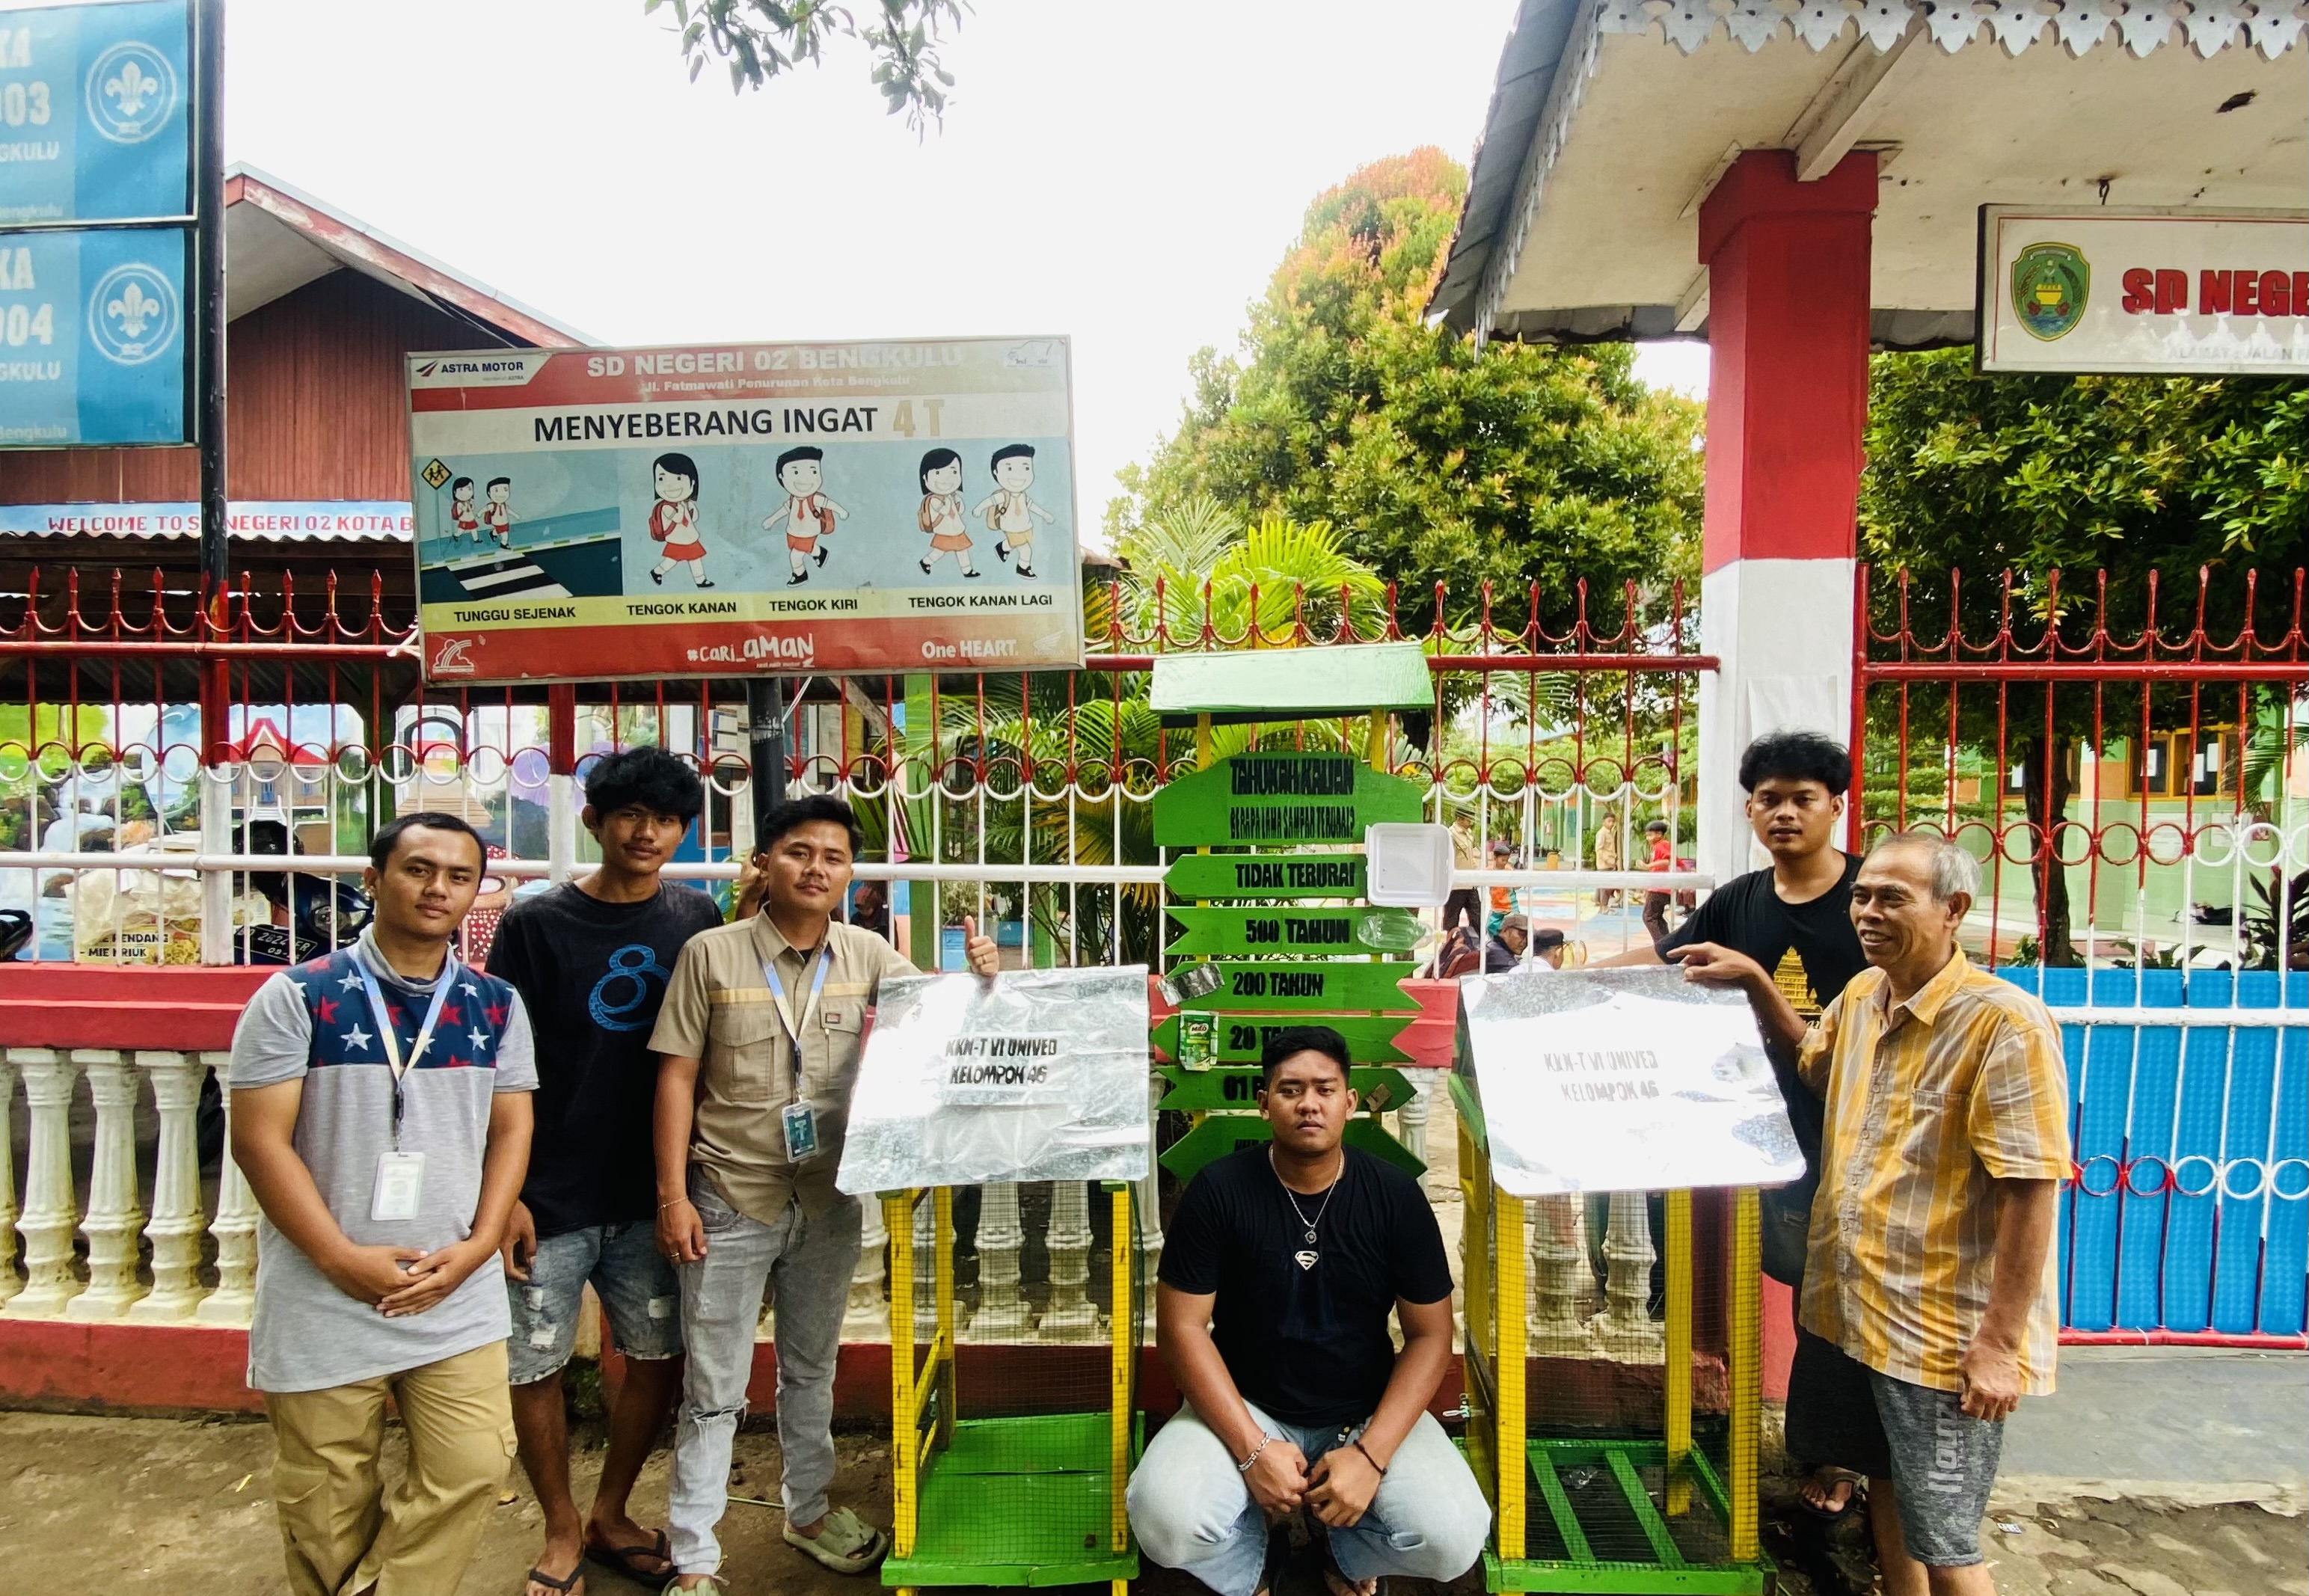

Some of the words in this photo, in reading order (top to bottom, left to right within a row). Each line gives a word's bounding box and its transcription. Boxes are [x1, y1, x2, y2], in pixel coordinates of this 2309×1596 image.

[0, 81, 51, 126] 03
[2121, 268, 2188, 316] SD
[0, 302, 54, 347] 04
[441, 363, 479, 374] ASTRA
[482, 361, 524, 372] MOTOR
[586, 356, 625, 378] SD
[635, 352, 744, 375] NEGERI
[753, 350, 789, 372] 02
[798, 346, 963, 370] BENGKULU
[664, 380, 734, 392] Fatmawati
[738, 378, 809, 389] Penurunan
[812, 376, 844, 387] Kota
[848, 375, 910, 388] Bengkulu
[534, 408, 773, 443] MENYEBERANG
[783, 407, 879, 434] INGAT
[48, 515, 148, 532] WELCOME
[156, 515, 183, 530] TO
[187, 516, 200, 530] S
[304, 515, 332, 531] 02
[337, 515, 394, 531] KOTA
[627, 603, 684, 616] TENGOK
[687, 601, 737, 614] KANAN
[769, 599, 827, 612] TENGOK
[830, 598, 859, 611] KIRI
[907, 596, 966, 608] TENGOK
[969, 595, 1017, 607] KANAN
[1021, 594, 1053, 606] LAGI
[453, 609, 510, 622] TUNGGU
[513, 607, 576, 620] SEJENAK
[921, 640, 957, 660] One
[1234, 863, 1284, 888] TIDAK
[1245, 918, 1280, 944] 500
[1285, 918, 1350, 944] TAHUN
[88, 948, 110, 957] MIE
[113, 948, 147, 957] RIUK
[1232, 972, 1266, 997] 200
[1269, 972, 1324, 997] TAHUN
[945, 1037, 988, 1058] KKN-T
[990, 1037, 1005, 1057] VI
[1007, 1037, 1058, 1056] UNIVED
[1230, 1025, 1257, 1050] 20
[949, 1065, 1025, 1085] KELOMPOK
[1223, 1075, 1248, 1101] 01
